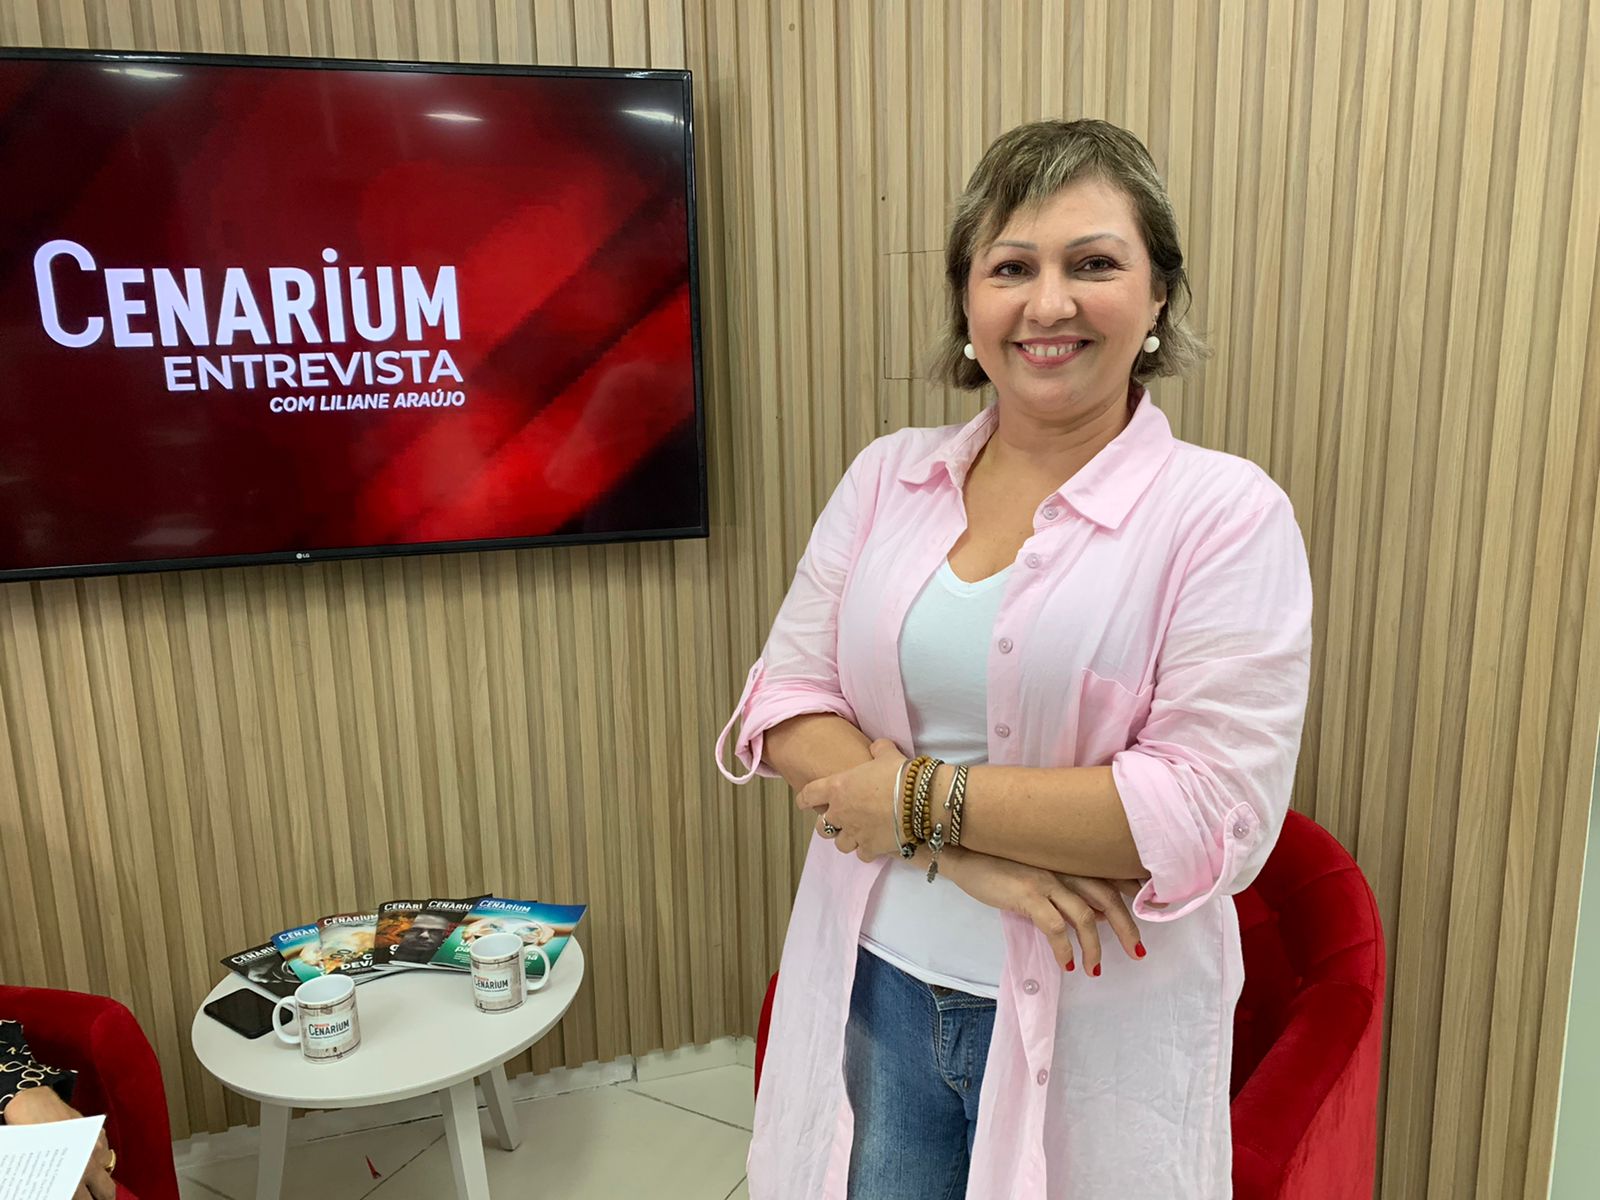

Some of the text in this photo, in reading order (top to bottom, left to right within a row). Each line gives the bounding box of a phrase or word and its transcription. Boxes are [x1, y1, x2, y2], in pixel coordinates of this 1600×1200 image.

[163, 349, 464, 391] ENTREVISTA
[269, 389, 466, 413] COM LILIANE ARAÚJO
